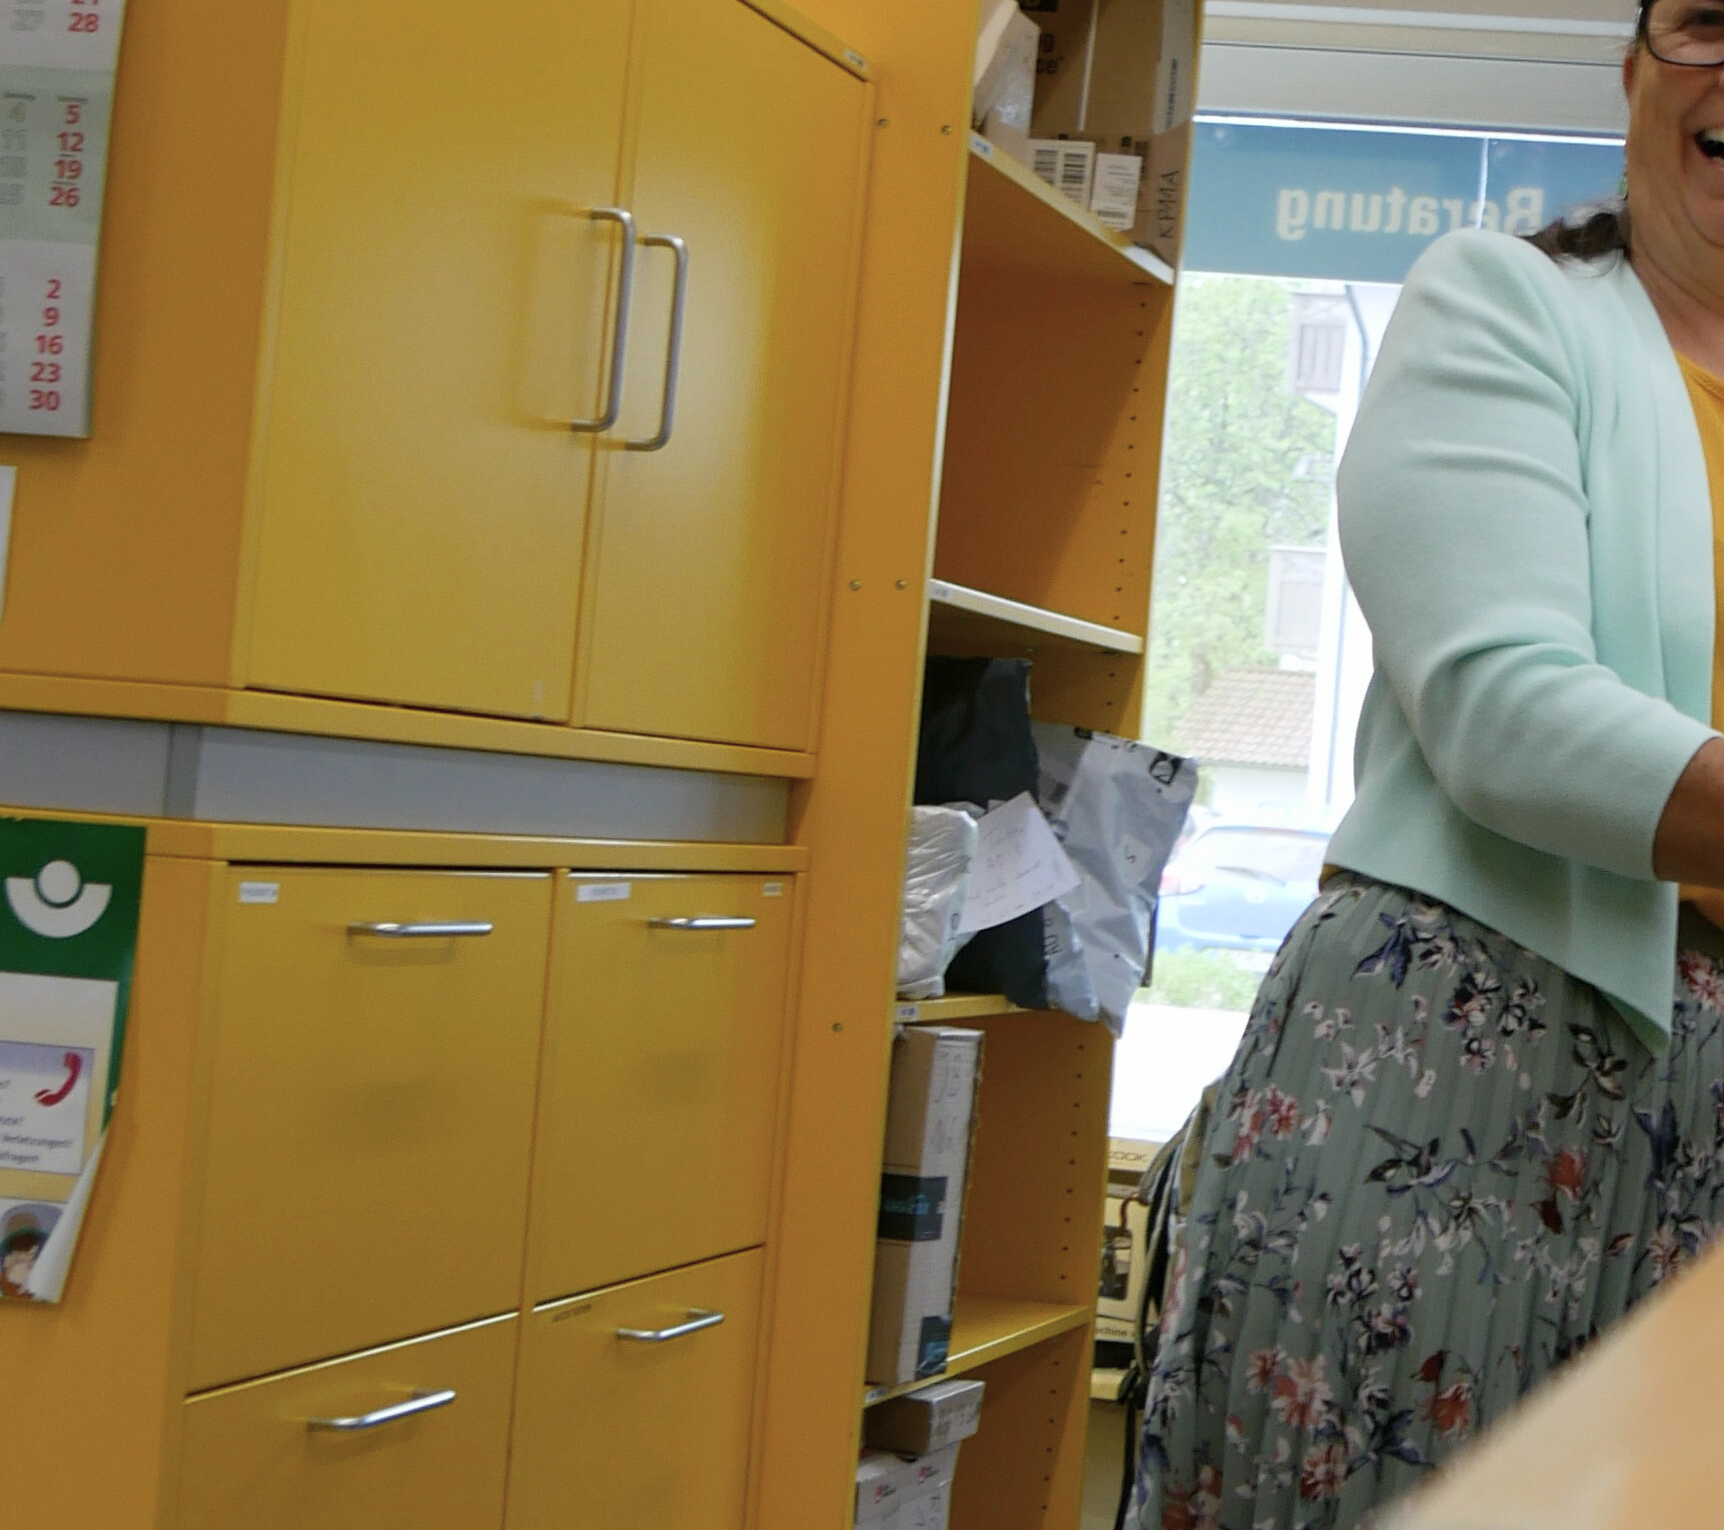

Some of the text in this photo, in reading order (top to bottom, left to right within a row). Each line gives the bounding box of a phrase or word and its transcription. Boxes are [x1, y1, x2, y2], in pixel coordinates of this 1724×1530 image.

[68, 12, 99, 32] 28
[65, 104, 80, 124] 5
[57, 131, 84, 152] 12
[54, 159, 82, 180] 19
[49, 186, 80, 207] 26
[46, 279, 61, 299] 2
[44, 307, 60, 327] 9
[35, 335, 64, 354] 16
[30, 362, 61, 383] 23
[28, 389, 61, 411] 30
